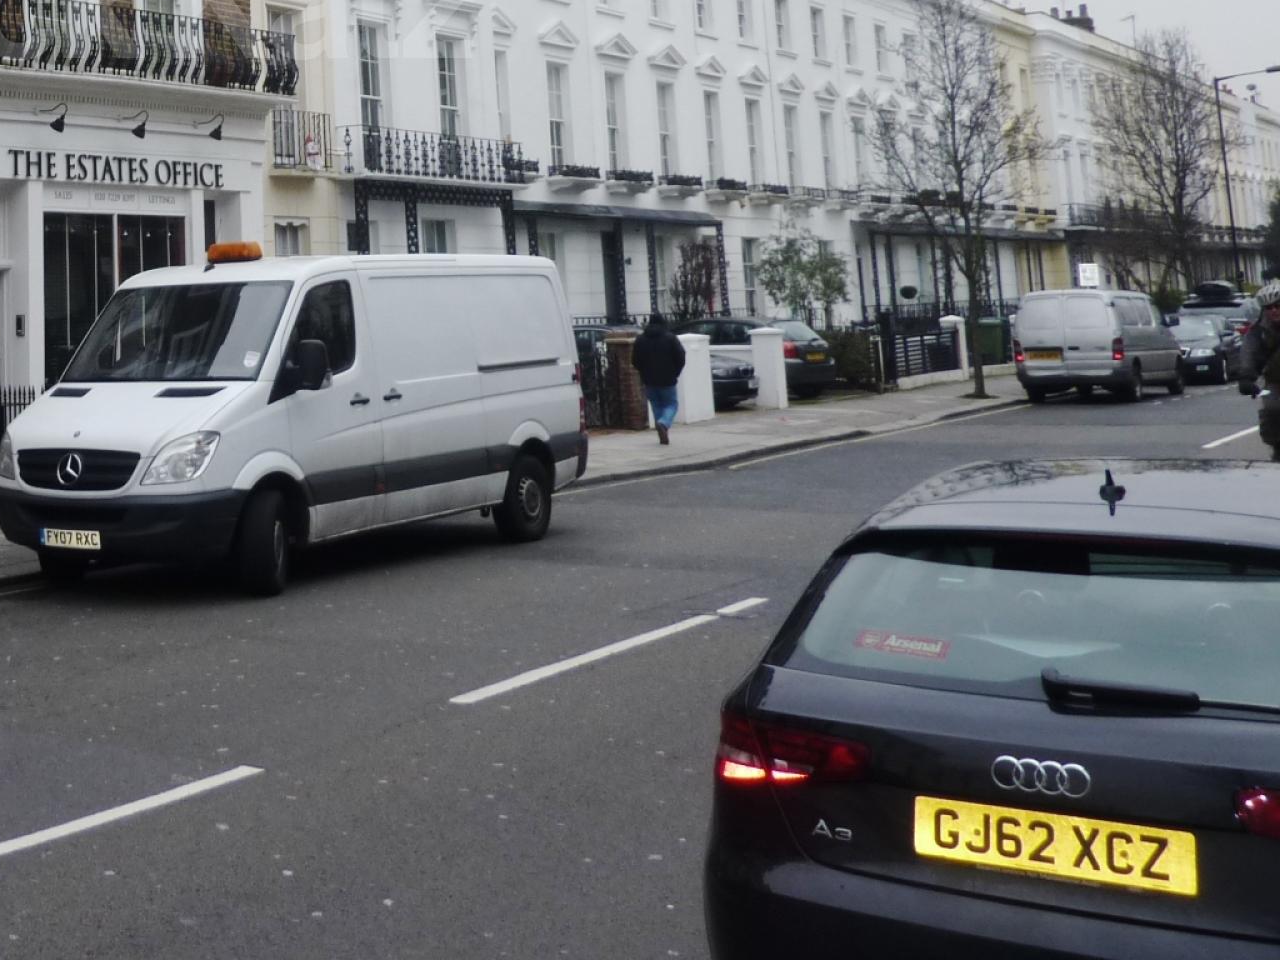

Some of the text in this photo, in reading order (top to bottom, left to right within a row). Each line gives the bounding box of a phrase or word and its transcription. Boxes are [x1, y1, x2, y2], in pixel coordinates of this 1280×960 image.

[8, 149, 225, 189] THE ESTATES OFFICE
[46, 530, 99, 546] FY07 RXC
[884, 634, 943, 654] Arsenal
[811, 818, 853, 841] A3
[933, 807, 1056, 865] GJ62
[1072, 824, 1171, 882] XCZ
